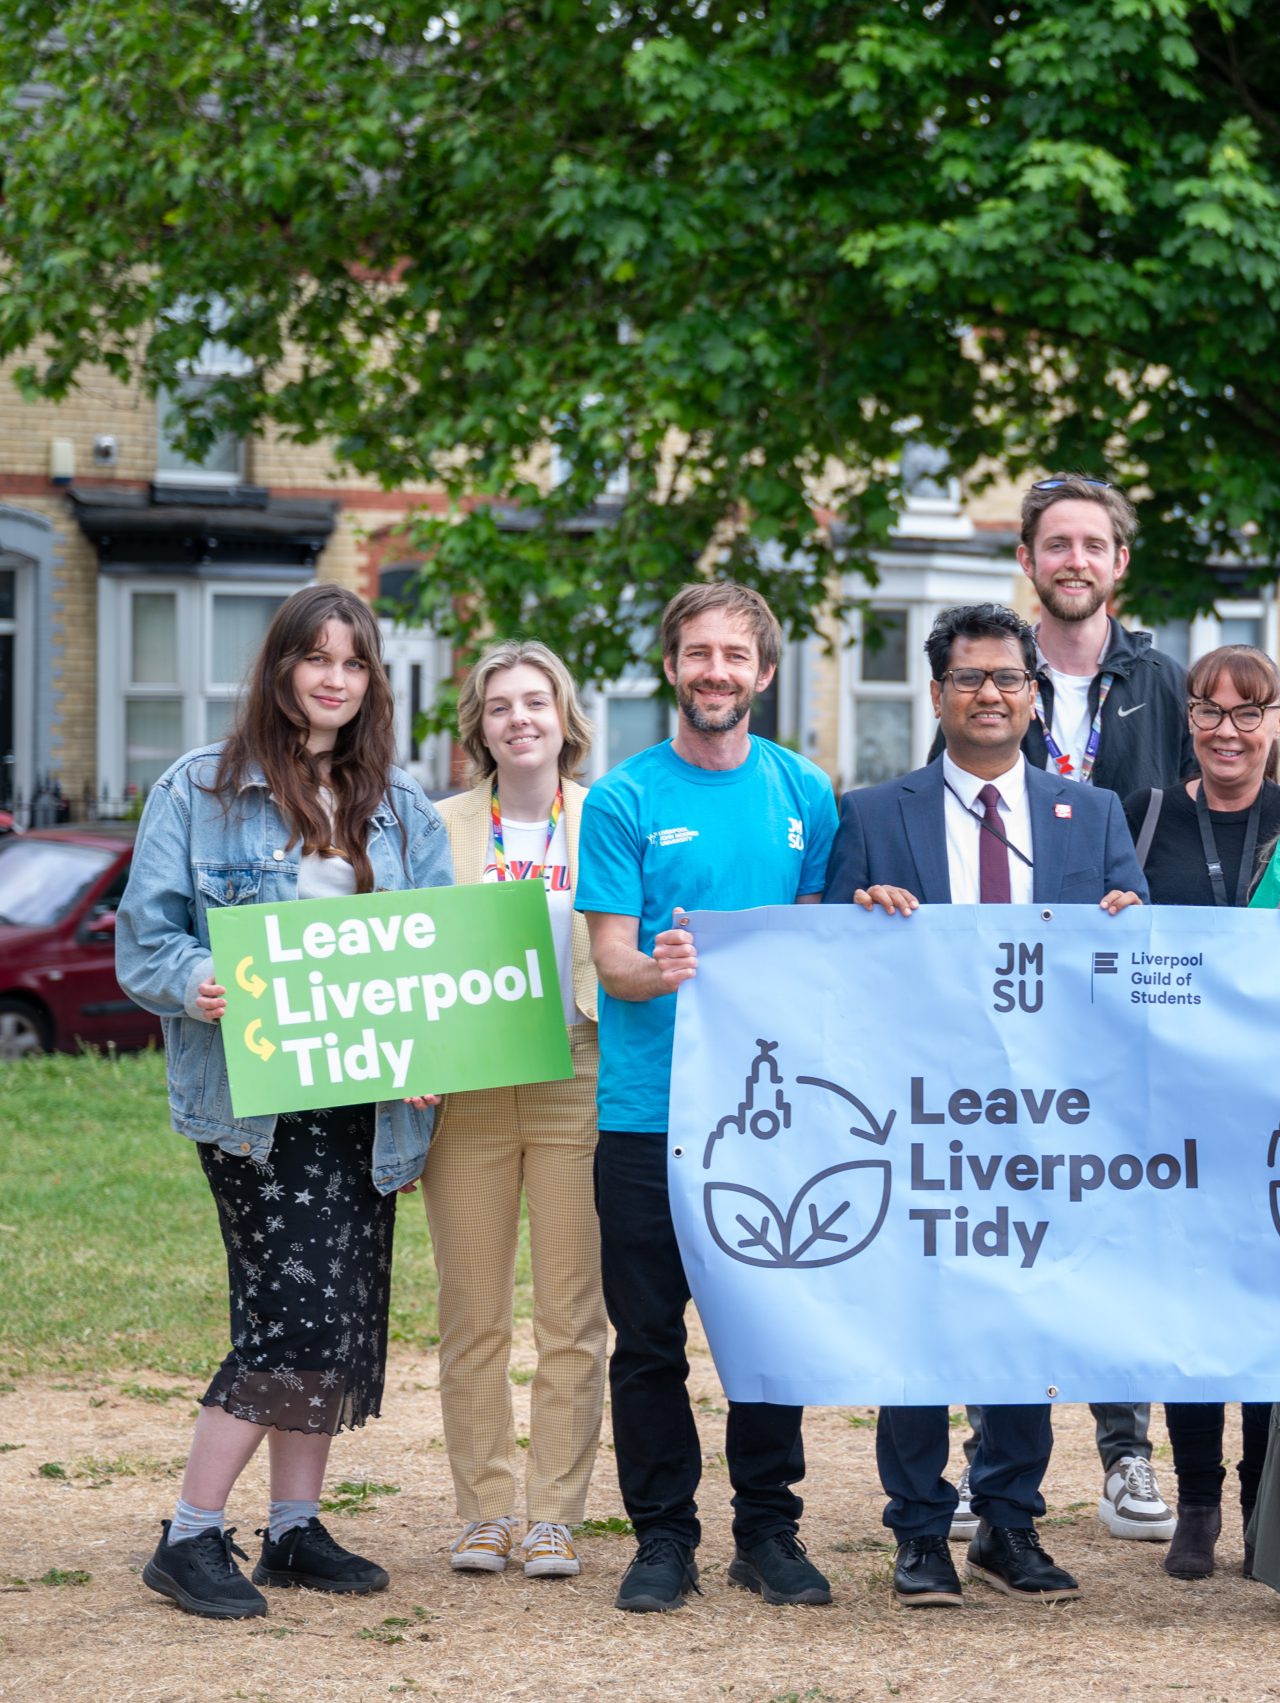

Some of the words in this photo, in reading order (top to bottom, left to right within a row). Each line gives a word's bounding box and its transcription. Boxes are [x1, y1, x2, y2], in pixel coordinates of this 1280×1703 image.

[264, 912, 437, 963] Leave
[995, 942, 1044, 976] JM
[1131, 952, 1203, 968] Liverpool
[272, 948, 544, 1026] Liverpool
[992, 979, 1044, 1014] SU
[1130, 990, 1202, 1005] Students
[1131, 971, 1171, 986] Guild
[1176, 972, 1193, 986] of
[281, 1028, 415, 1088] Tidy
[910, 1076, 1091, 1126] Leave
[910, 1138, 1199, 1203] Liverpool
[908, 1205, 1050, 1269] Tidy
